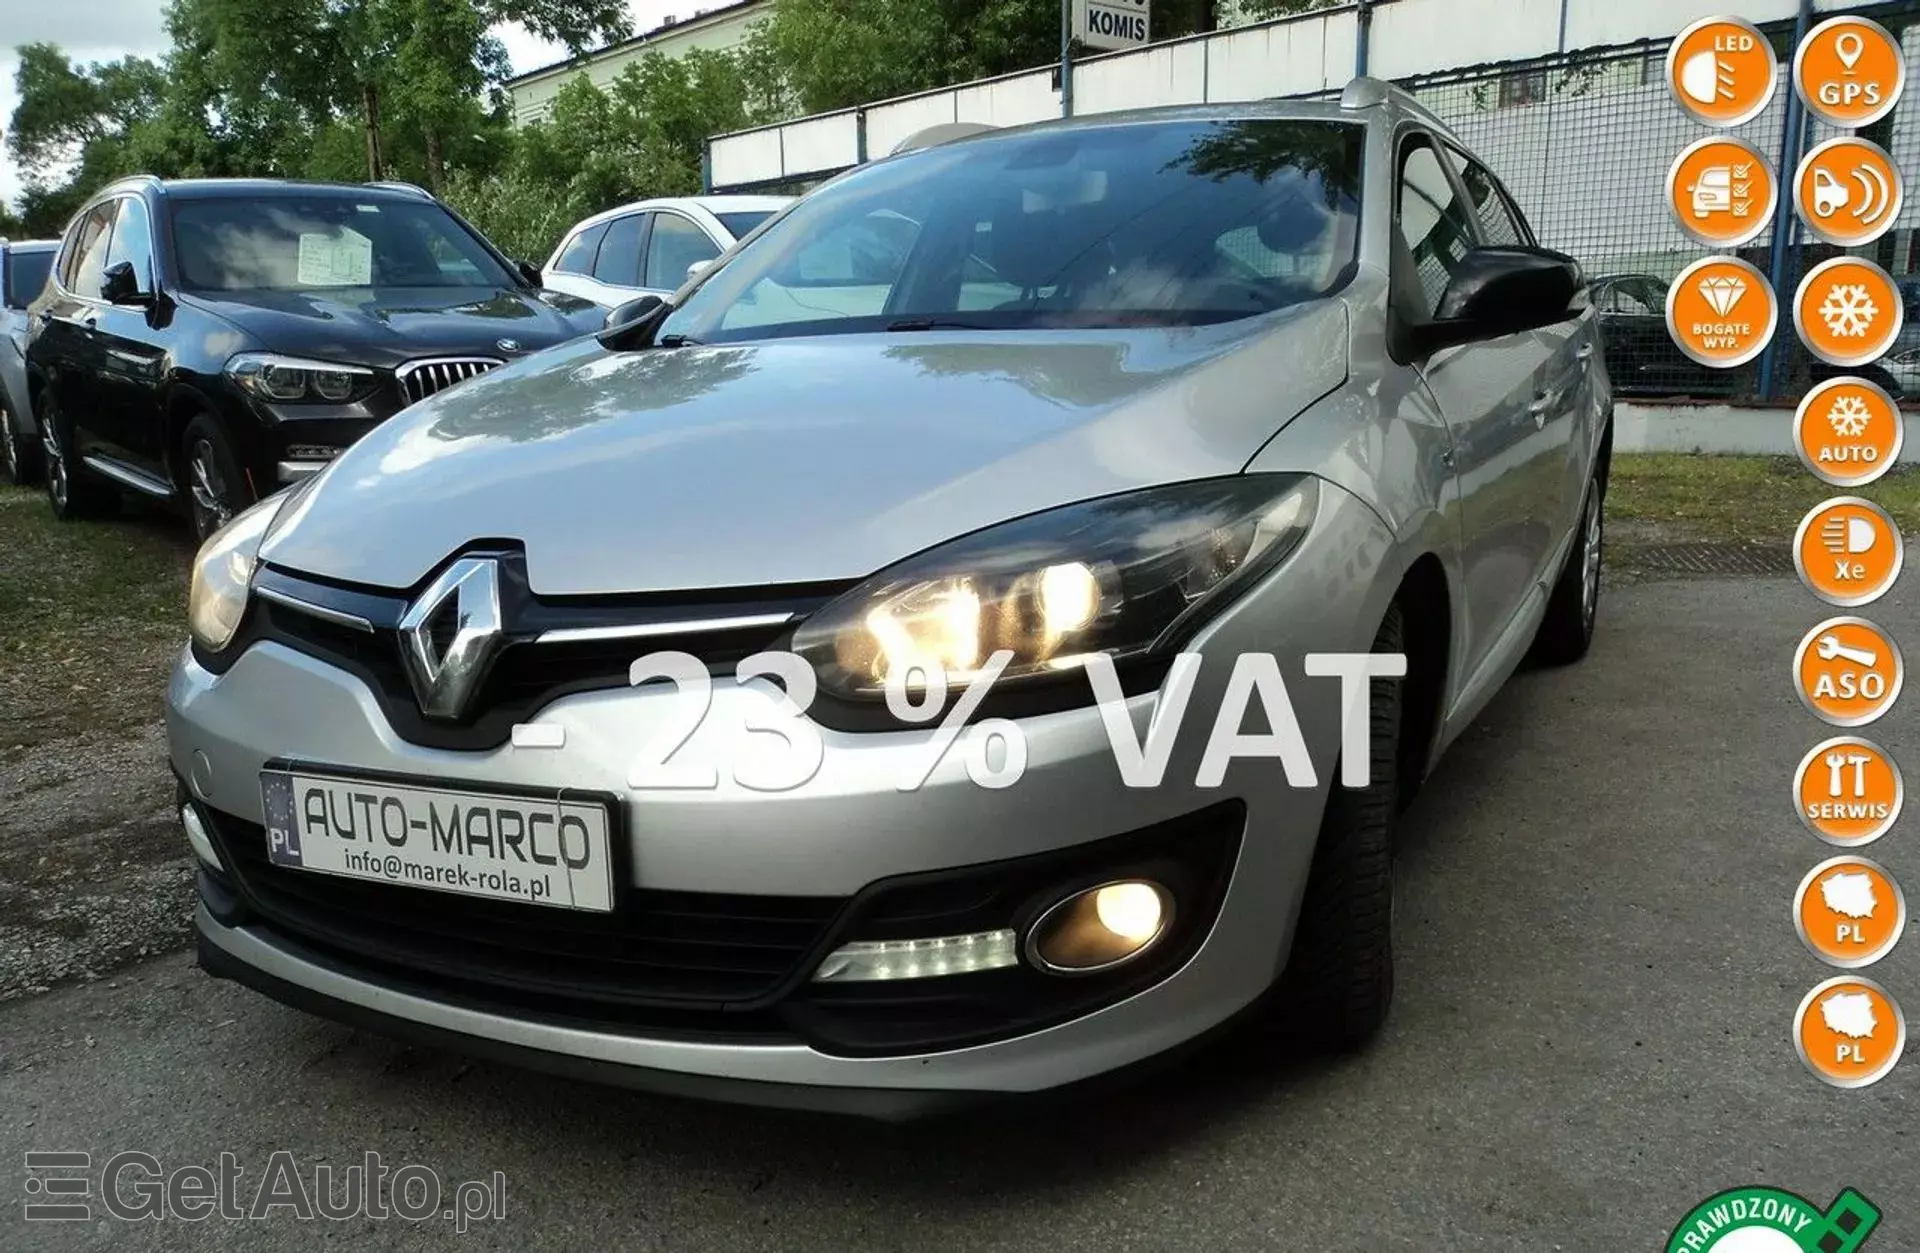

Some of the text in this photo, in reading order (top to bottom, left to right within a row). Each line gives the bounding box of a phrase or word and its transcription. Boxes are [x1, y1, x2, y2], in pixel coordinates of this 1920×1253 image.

[1088, 9, 1145, 41] KOMIS
[270, 826, 300, 856] PL
[304, 787, 591, 870] AUTO-MARCO
[344, 847, 552, 902] info@marek-rola.pl
